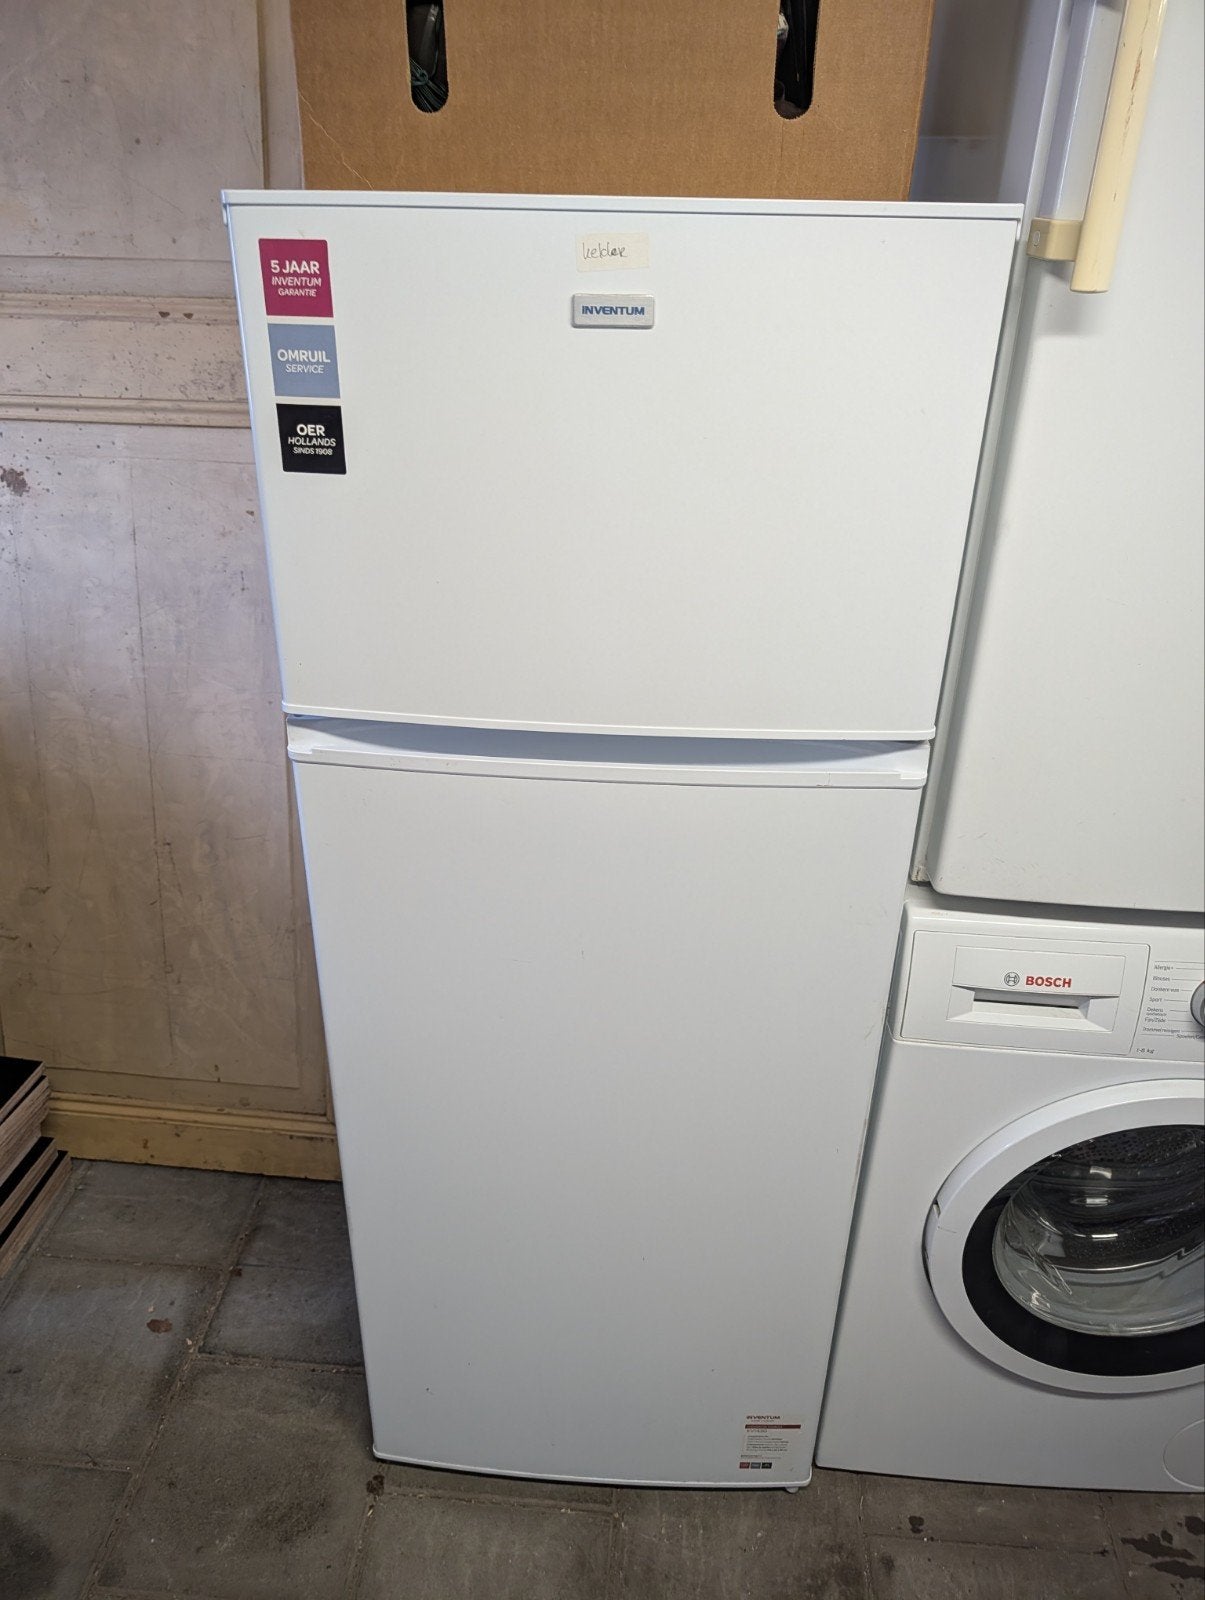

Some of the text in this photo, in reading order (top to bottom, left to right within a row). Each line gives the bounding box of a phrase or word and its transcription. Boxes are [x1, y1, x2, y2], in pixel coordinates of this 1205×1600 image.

[270, 260, 320, 274] 5 JAAR
[271, 276, 322, 287] INVENTUM
[278, 288, 317, 297] GARANTIE
[581, 305, 645, 316] INVENTUM
[277, 349, 331, 363] OMRUIL
[285, 363, 325, 374] SERVICE
[296, 424, 326, 437] OER
[288, 437, 337, 447] HOLLANDS
[293, 446, 333, 456] SINDS 1908
[1025, 975, 1072, 988] BOSCH
